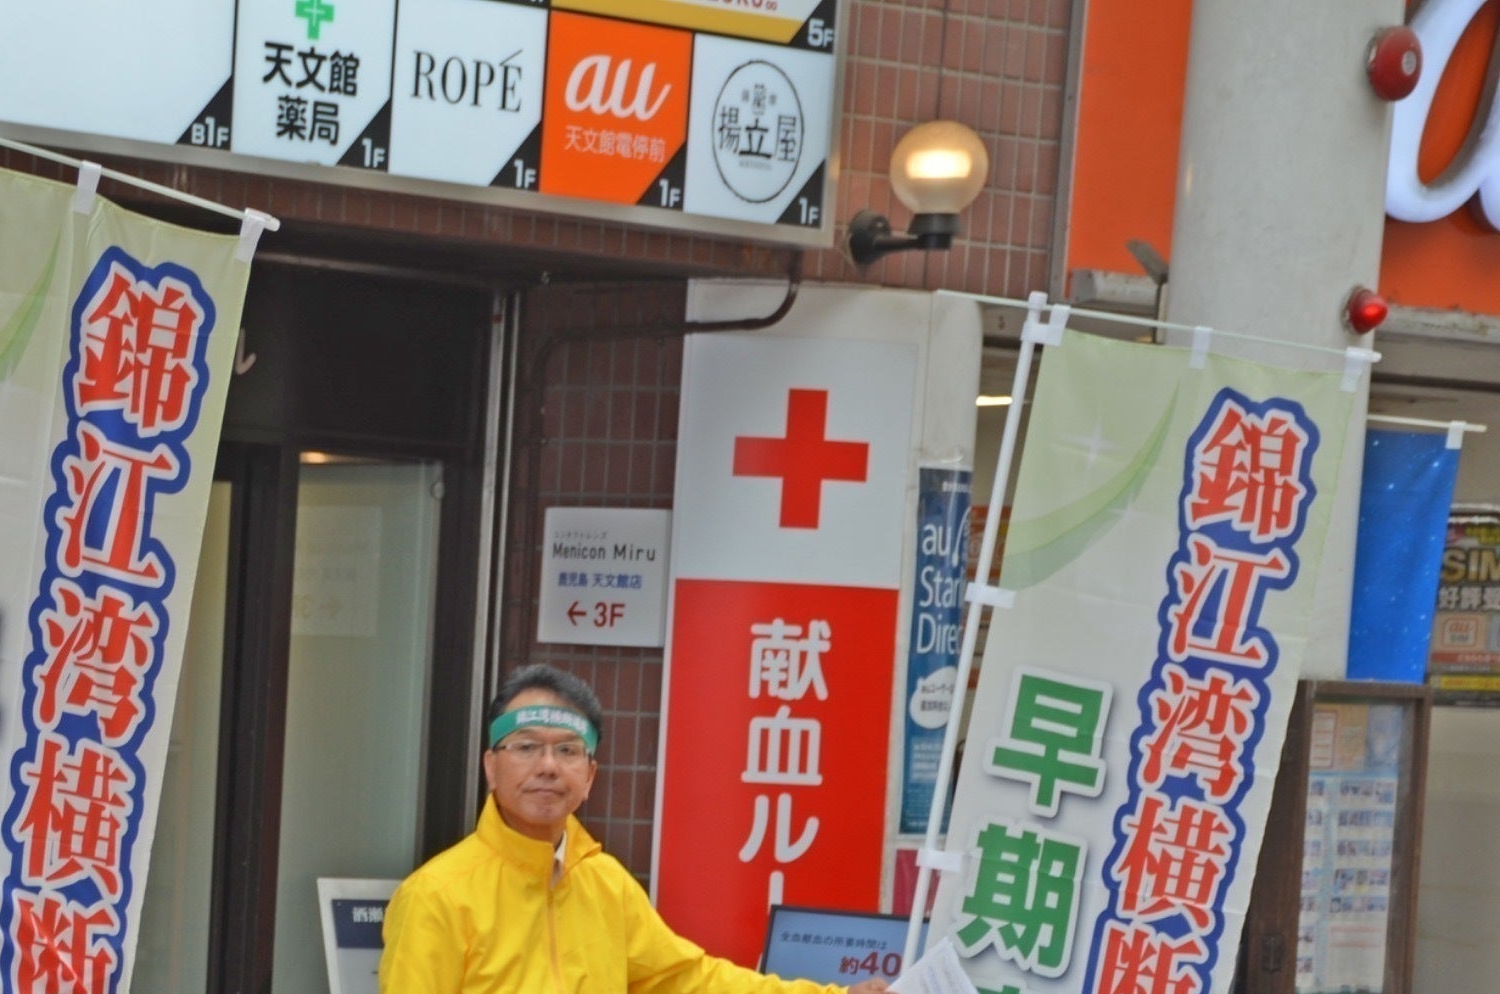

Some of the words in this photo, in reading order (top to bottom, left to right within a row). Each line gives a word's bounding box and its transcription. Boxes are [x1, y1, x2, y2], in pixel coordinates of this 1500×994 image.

[808, 18, 834, 48] 5F
[262, 40, 360, 97] 天文館
[410, 48, 524, 113] ROPÉ
[564, 53, 673, 121] au
[191, 116, 230, 149] B1F
[276, 94, 340, 146] 薬局
[361, 137, 387, 169] 1F
[564, 124, 668, 164] 天文館電停前
[513, 158, 537, 190] 1F
[659, 178, 682, 208] 1F
[799, 197, 821, 225] 1F
[552, 541, 606, 561] Menicon
[612, 543, 657, 562] Miru
[922, 522, 952, 557] au
[594, 601, 626, 628] 3F
[780, 931, 888, 950] 全血献血の所要時間は
